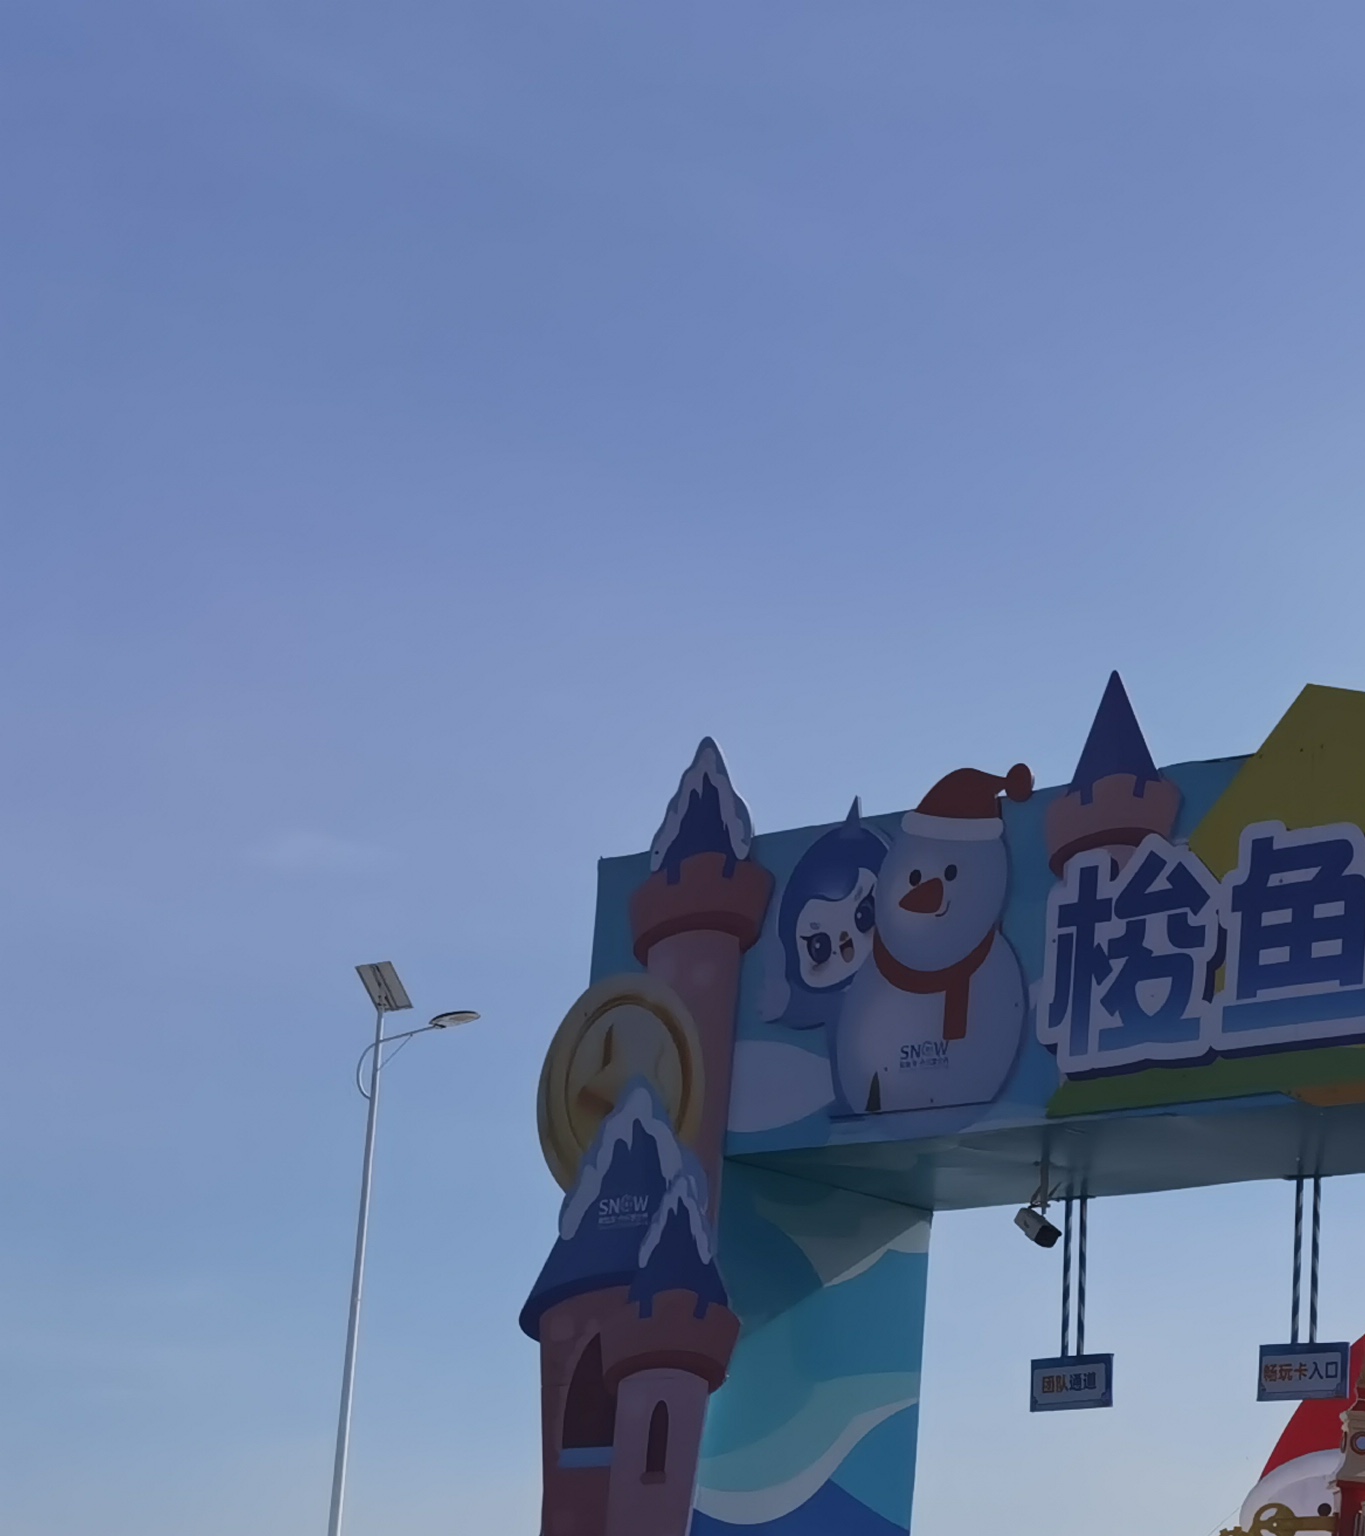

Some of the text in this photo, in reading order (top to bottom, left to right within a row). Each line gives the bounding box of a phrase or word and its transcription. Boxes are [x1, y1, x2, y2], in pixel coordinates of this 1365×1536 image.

[900, 1040, 949, 1060] SNOW
[599, 1194, 649, 1215] SNOW
[1263, 1361, 1340, 1382] 畅玩卡入口
[1041, 1372, 1098, 1393] 团队通道
